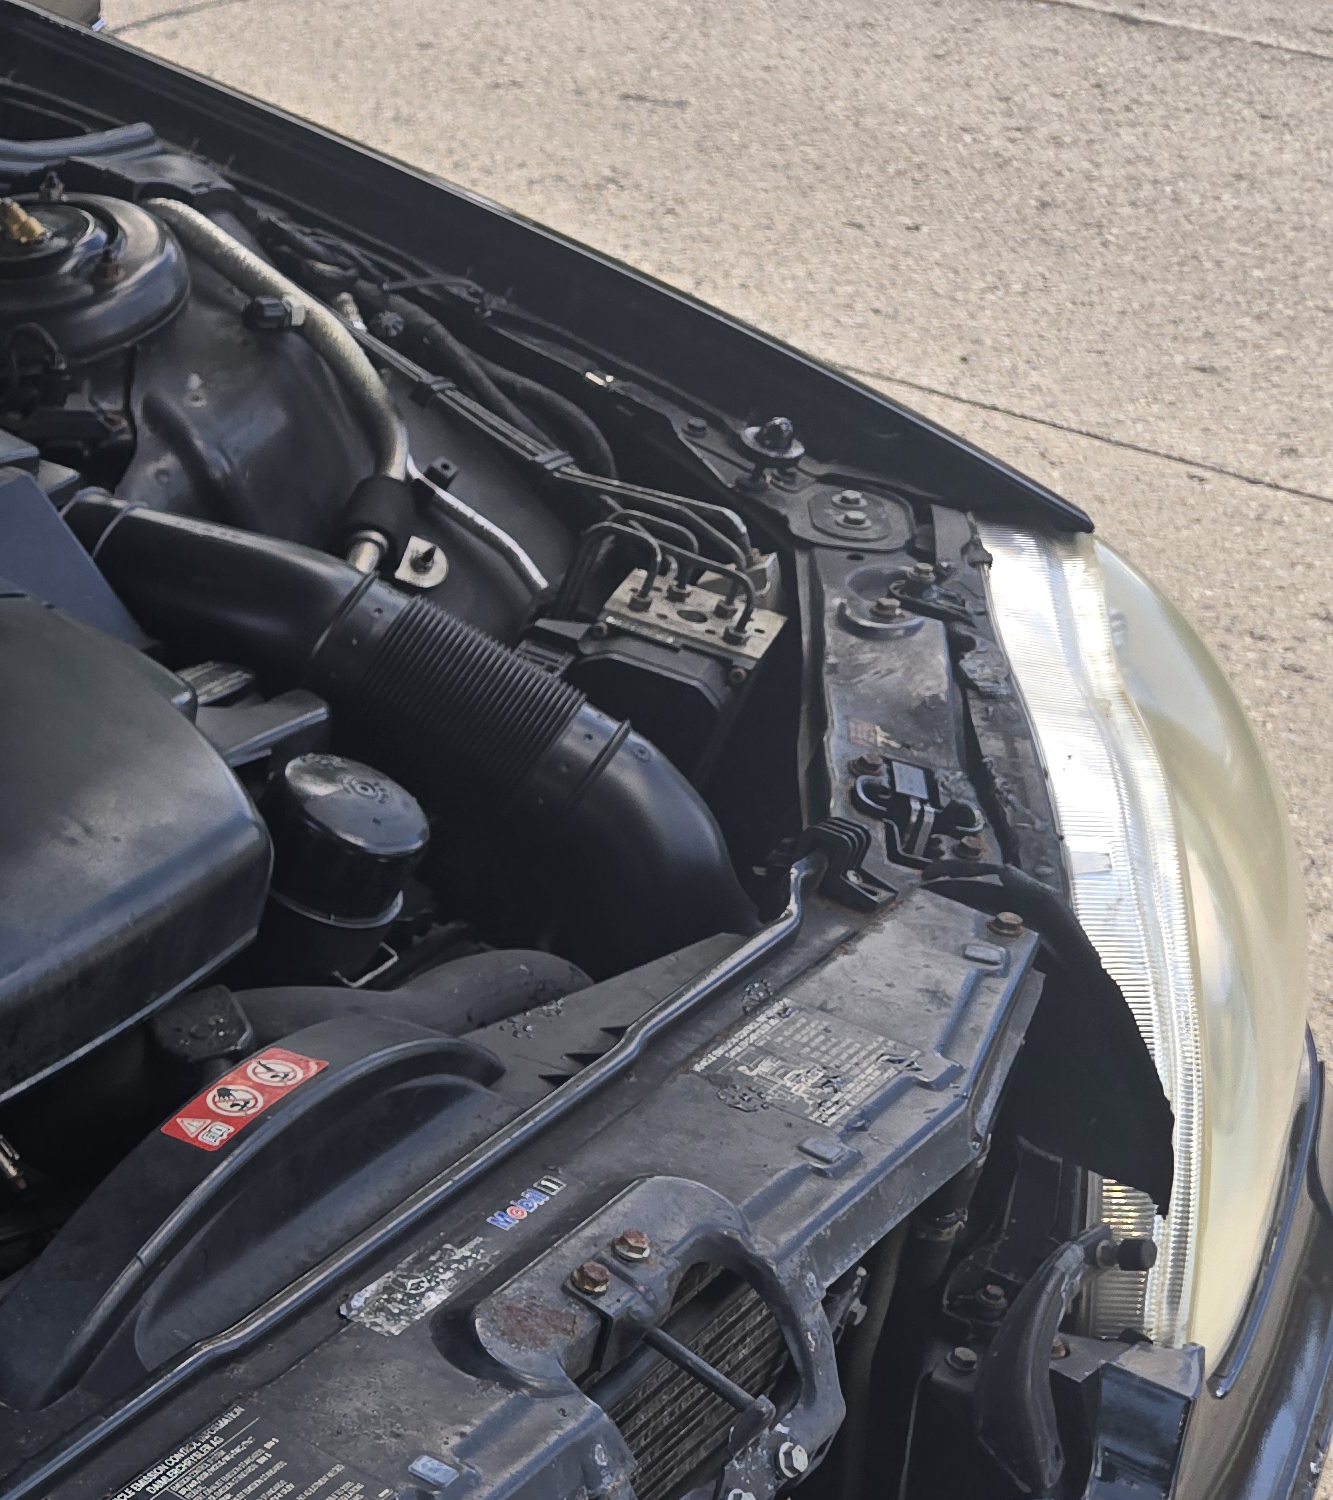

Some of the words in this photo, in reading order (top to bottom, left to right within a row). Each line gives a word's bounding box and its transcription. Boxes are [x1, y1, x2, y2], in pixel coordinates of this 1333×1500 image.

[486, 1188, 550, 1231] Mobil
[129, 1462, 169, 1491] EMISSION
[145, 1442, 214, 1494] DAIMLERCHRYSLER
